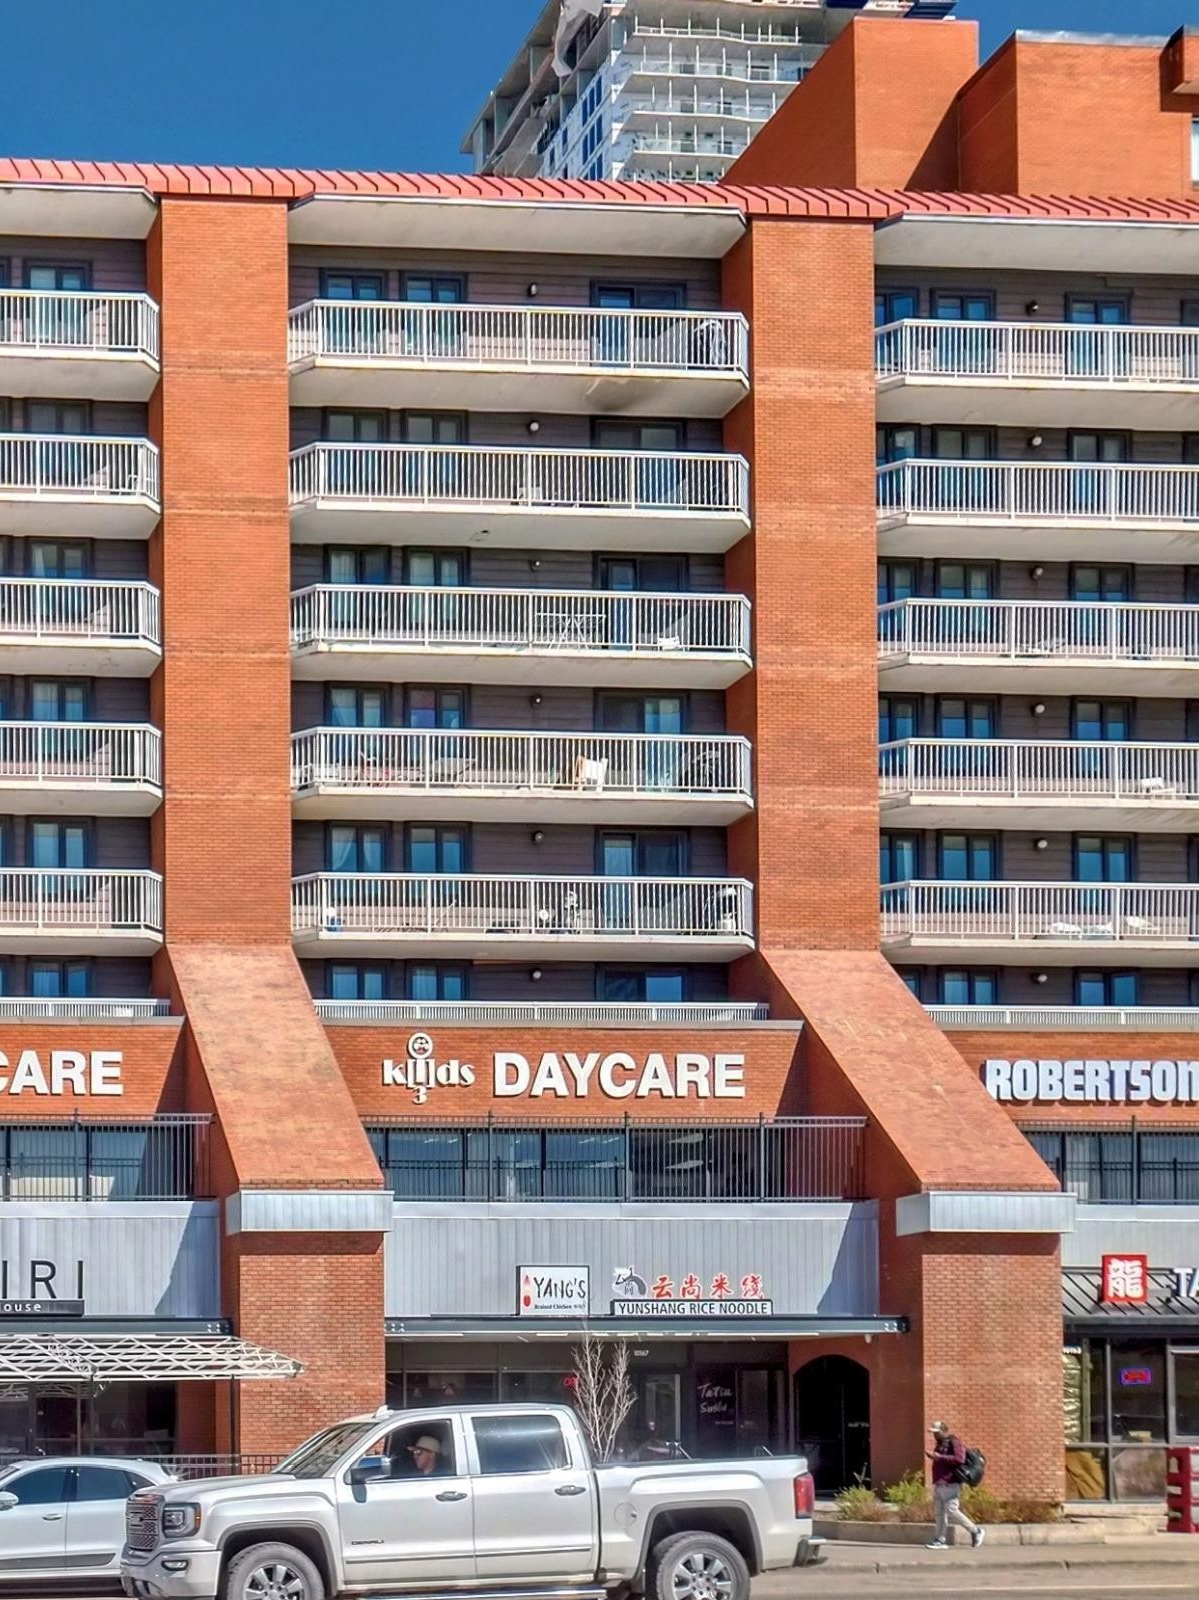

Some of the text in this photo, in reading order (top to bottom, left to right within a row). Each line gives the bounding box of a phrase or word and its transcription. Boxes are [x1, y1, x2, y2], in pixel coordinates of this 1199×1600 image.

[492, 1051, 746, 1099] DAYCARE
[985, 1059, 1199, 1101] ROBERTSON
[533, 1276, 586, 1299] YANG'S
[618, 1302, 768, 1315] YUNSHANG RICE NOODLE
